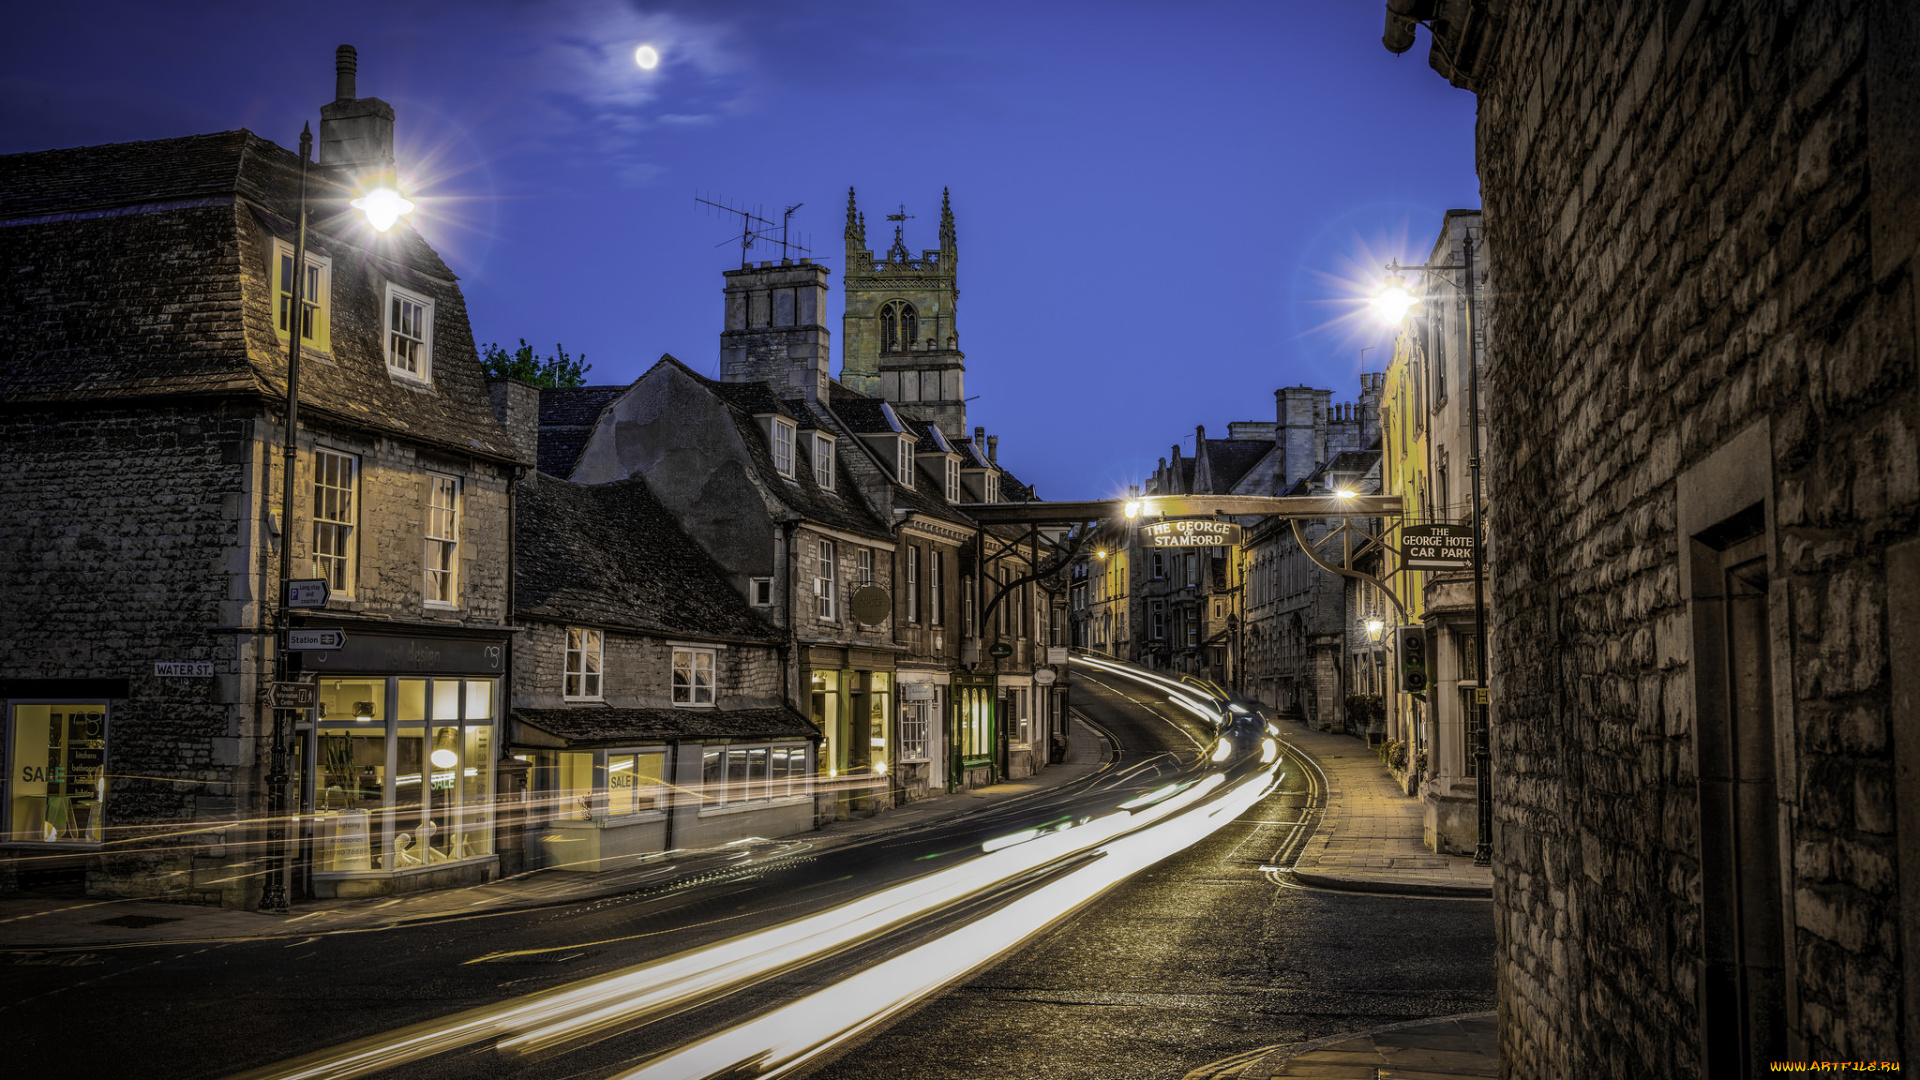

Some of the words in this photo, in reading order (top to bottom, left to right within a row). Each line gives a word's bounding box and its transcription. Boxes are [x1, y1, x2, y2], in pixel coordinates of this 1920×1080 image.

[1145, 523, 1171, 536] THE
[1177, 521, 1231, 534] GEORGE
[1430, 527, 1449, 536] THE
[1154, 535, 1223, 546] STAMFORD
[1402, 536, 1442, 546] GEORGE
[1446, 536, 1473, 547] HOTE
[1410, 547, 1435, 557] CAR
[1441, 548, 1472, 558] PARK
[291, 636, 319, 644] Station
[407, 641, 441, 667] design
[156, 664, 194, 675] WATER
[196, 664, 212, 675] ST.
[23, 766, 66, 783] SALE
[611, 775, 631, 788] SALE
